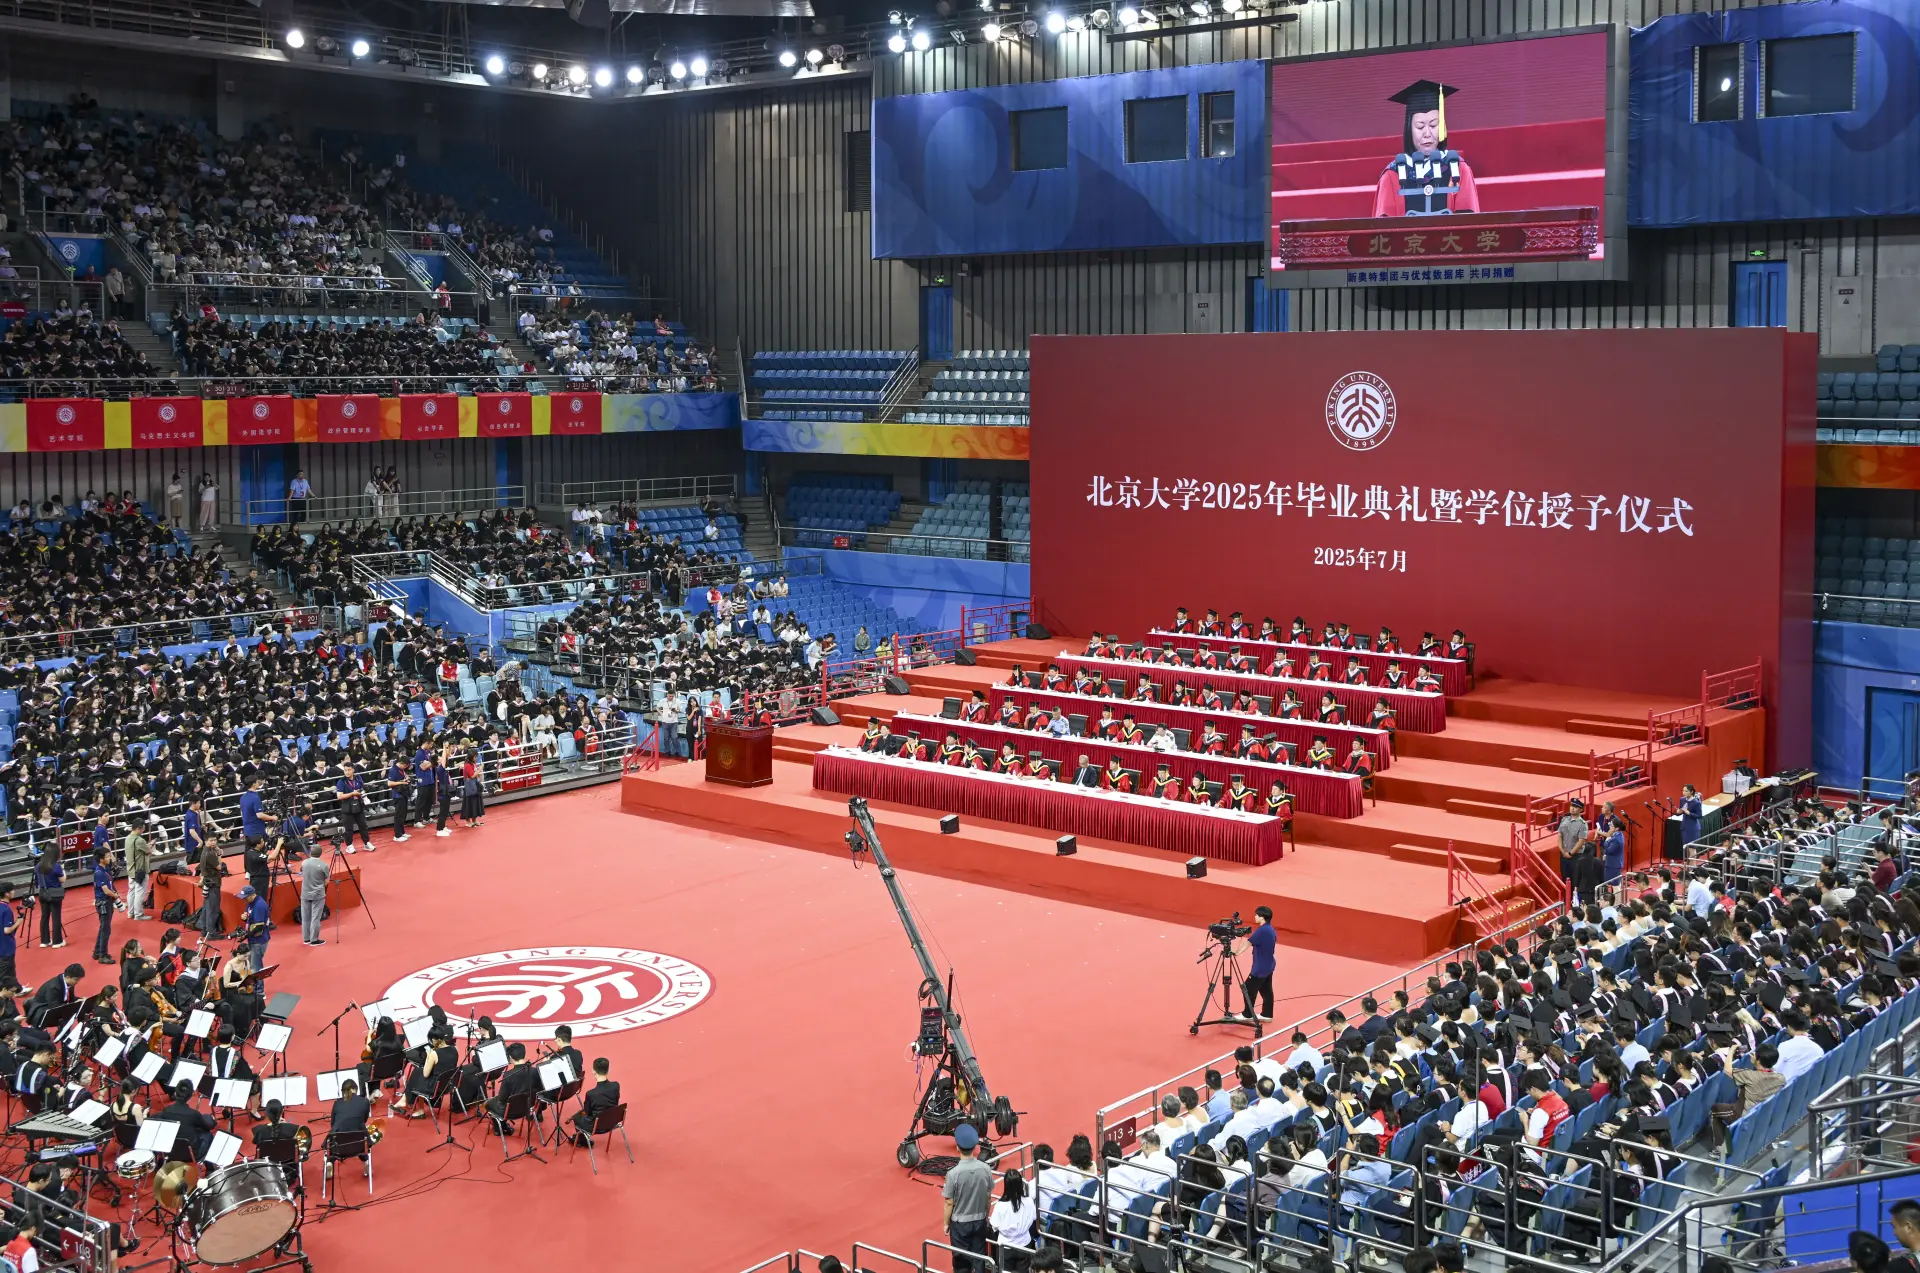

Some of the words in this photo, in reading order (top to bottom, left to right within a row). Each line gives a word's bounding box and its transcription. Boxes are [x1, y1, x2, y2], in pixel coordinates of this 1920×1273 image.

[1368, 230, 1501, 255] 北京大学
[1347, 266, 1465, 283] 新奥特集团与优炫数据库
[1469, 265, 1515, 279] 共同捐赠
[1328, 381, 1346, 427] PEKING
[1350, 374, 1394, 428] UNIVERSITY
[48, 434, 84, 443] 艺术学院
[139, 431, 196, 440] 马克思主义学院
[241, 428, 281, 436] 外国语学院
[1346, 438, 1376, 448] 1898
[1086, 474, 1695, 538] 北京大学2025年毕业典礼暨学位授予仪式
[1313, 546, 1407, 573] 2025年7月
[307, 615, 318, 623] 201
[63, 837, 78, 846] 103
[413, 947, 587, 982] PEKING
[588, 949, 706, 1033] UNIVERSITY
[1108, 1127, 1124, 1141] 113
